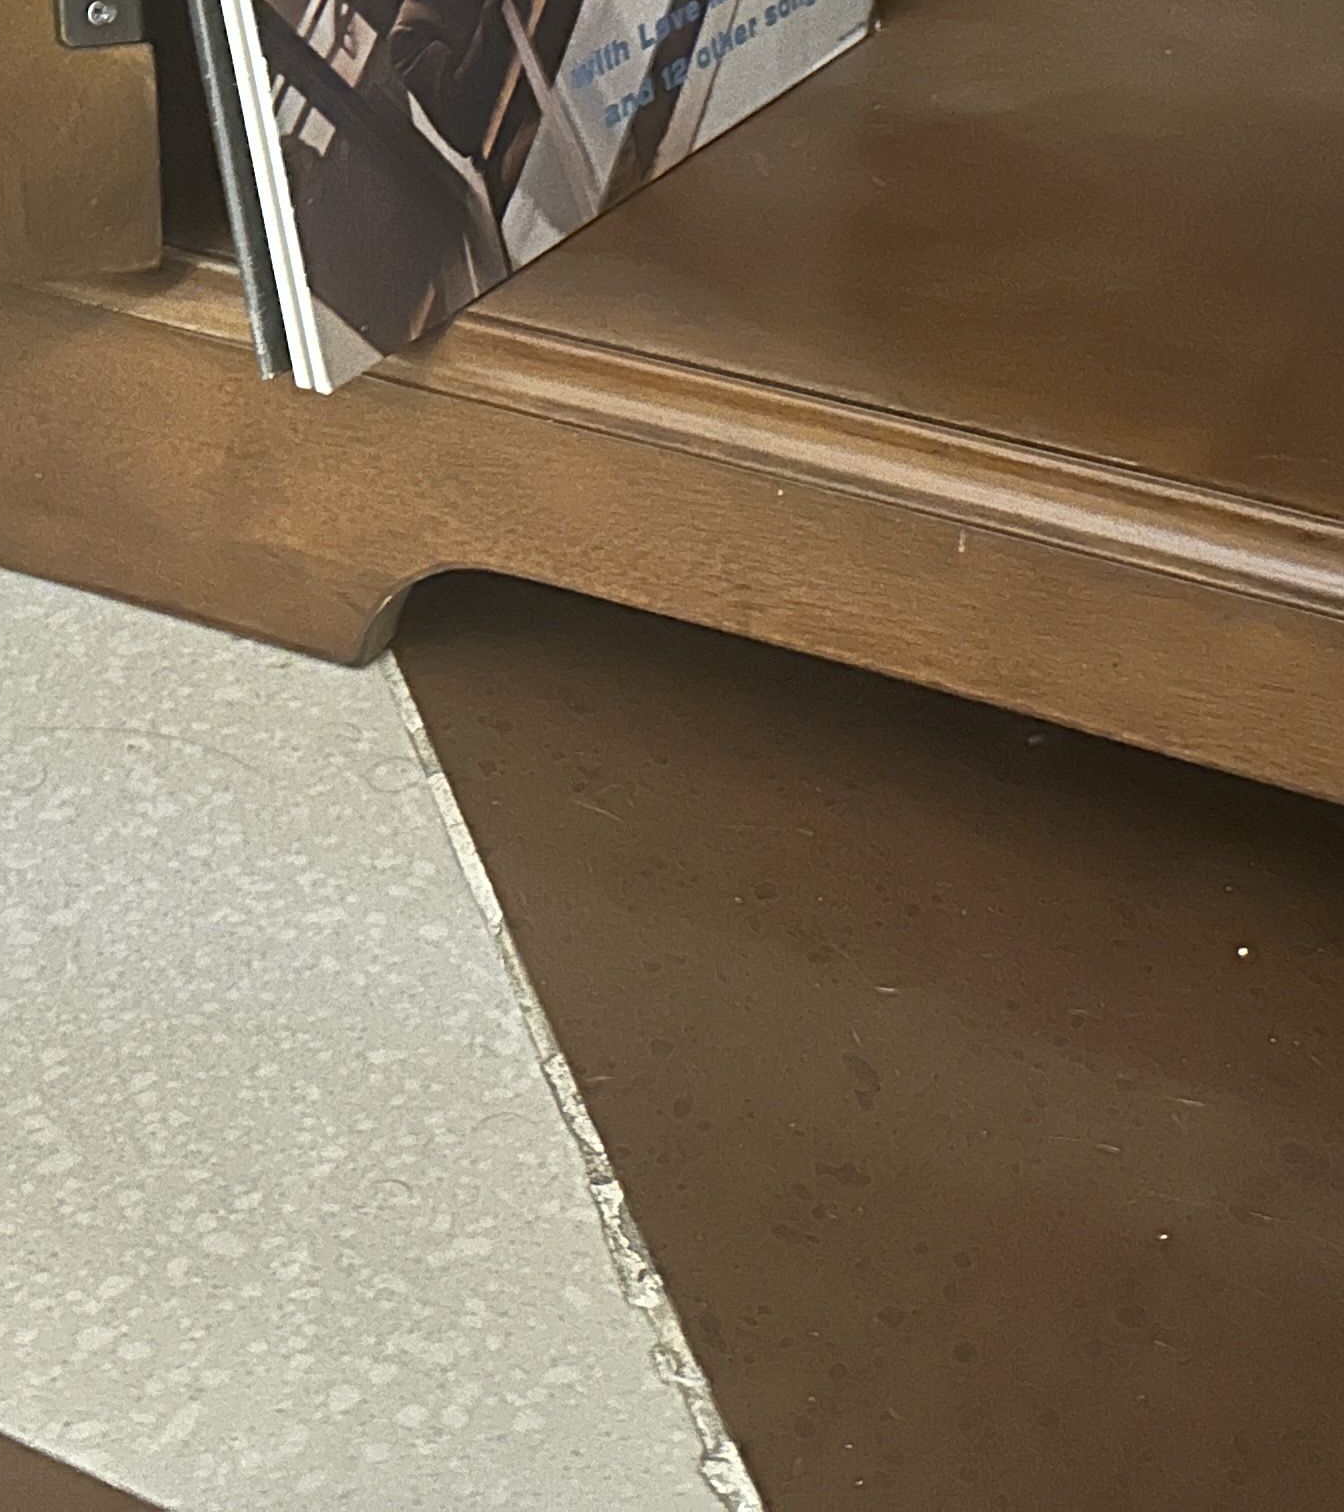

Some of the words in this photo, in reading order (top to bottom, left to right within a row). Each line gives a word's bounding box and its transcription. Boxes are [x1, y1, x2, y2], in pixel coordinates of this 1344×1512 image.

[570, 38, 631, 90] with
[637, 0, 702, 52] Love
[603, 70, 655, 130] and
[660, 56, 689, 92] 12
[696, 17, 759, 70] other
